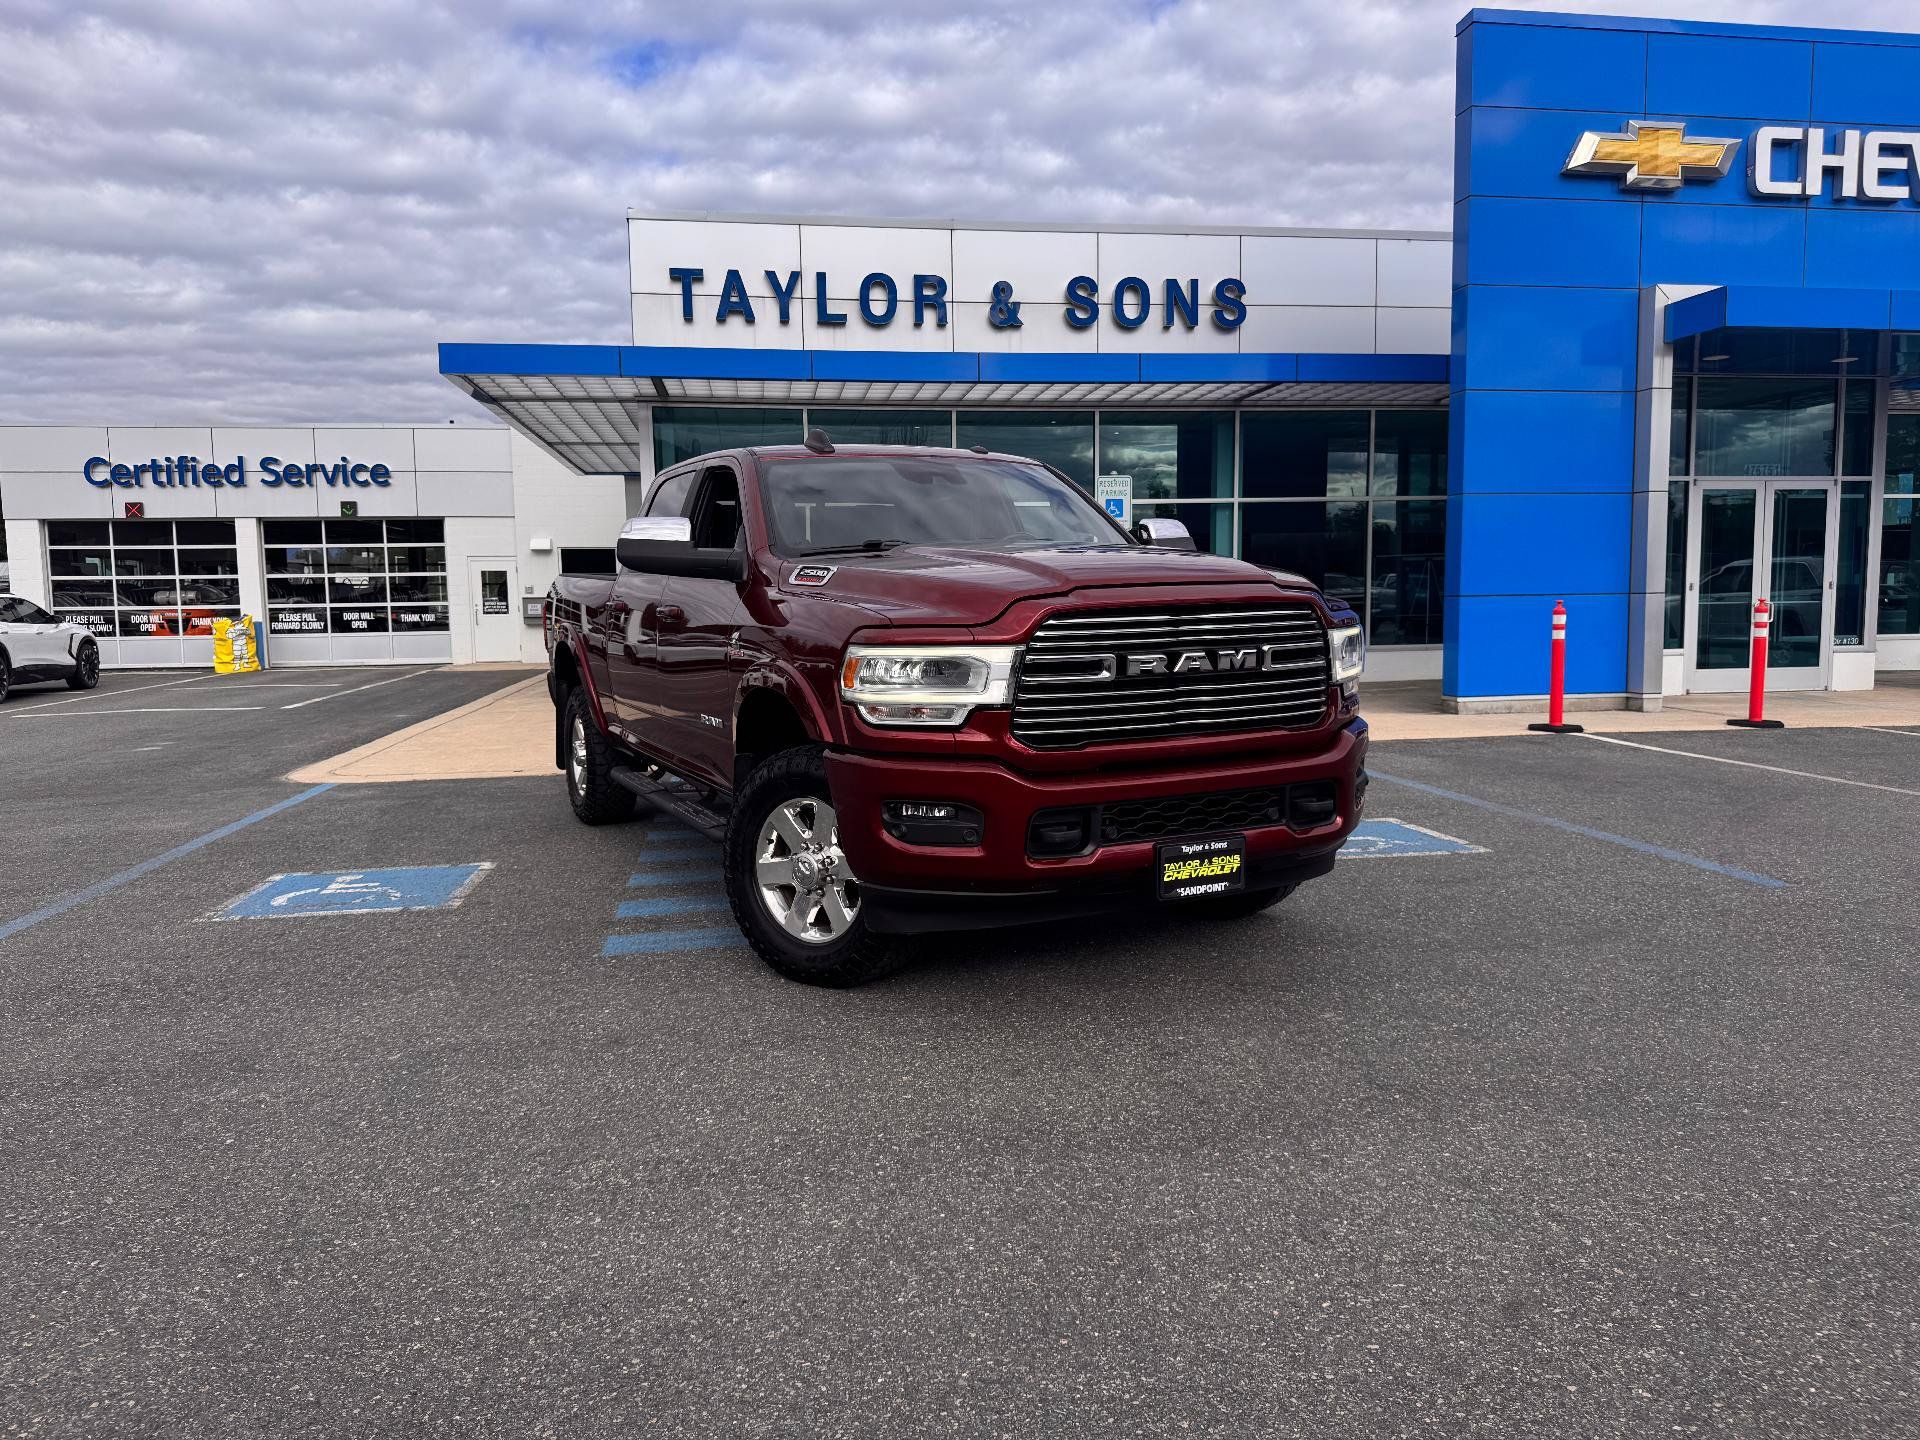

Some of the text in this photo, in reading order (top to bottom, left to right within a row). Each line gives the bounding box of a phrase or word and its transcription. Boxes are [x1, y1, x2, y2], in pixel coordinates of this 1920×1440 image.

[1753, 126, 1920, 201] CHE
[669, 267, 1247, 330] TAYLOR & SONS
[83, 455, 392, 488] Certified Service
[1099, 480, 1129, 488] RESERVED
[1100, 489, 1128, 497] PARKING
[800, 569, 828, 577] 2500
[65, 615, 106, 624] PLEASE PULL
[131, 615, 149, 623] DOOR
[149, 614, 165, 623] WILL
[278, 613, 317, 622] PLEASE PULL
[343, 612, 375, 621] DOOR WILL
[401, 613, 436, 622] THANK YOU!
[192, 617, 212, 626] THANK
[271, 621, 325, 630] FORWARD SLOWLY
[351, 620, 367, 629] OPEN
[89, 624, 113, 632] SLOWLY
[140, 623, 157, 632] OPEN
[1127, 650, 1257, 676] RAM
[1181, 844, 1203, 855] Taylor
[1210, 841, 1228, 850] Sons
[1163, 854, 1241, 872] TAYLOR & SONS
[1163, 863, 1241, 882] CHEVROLET
